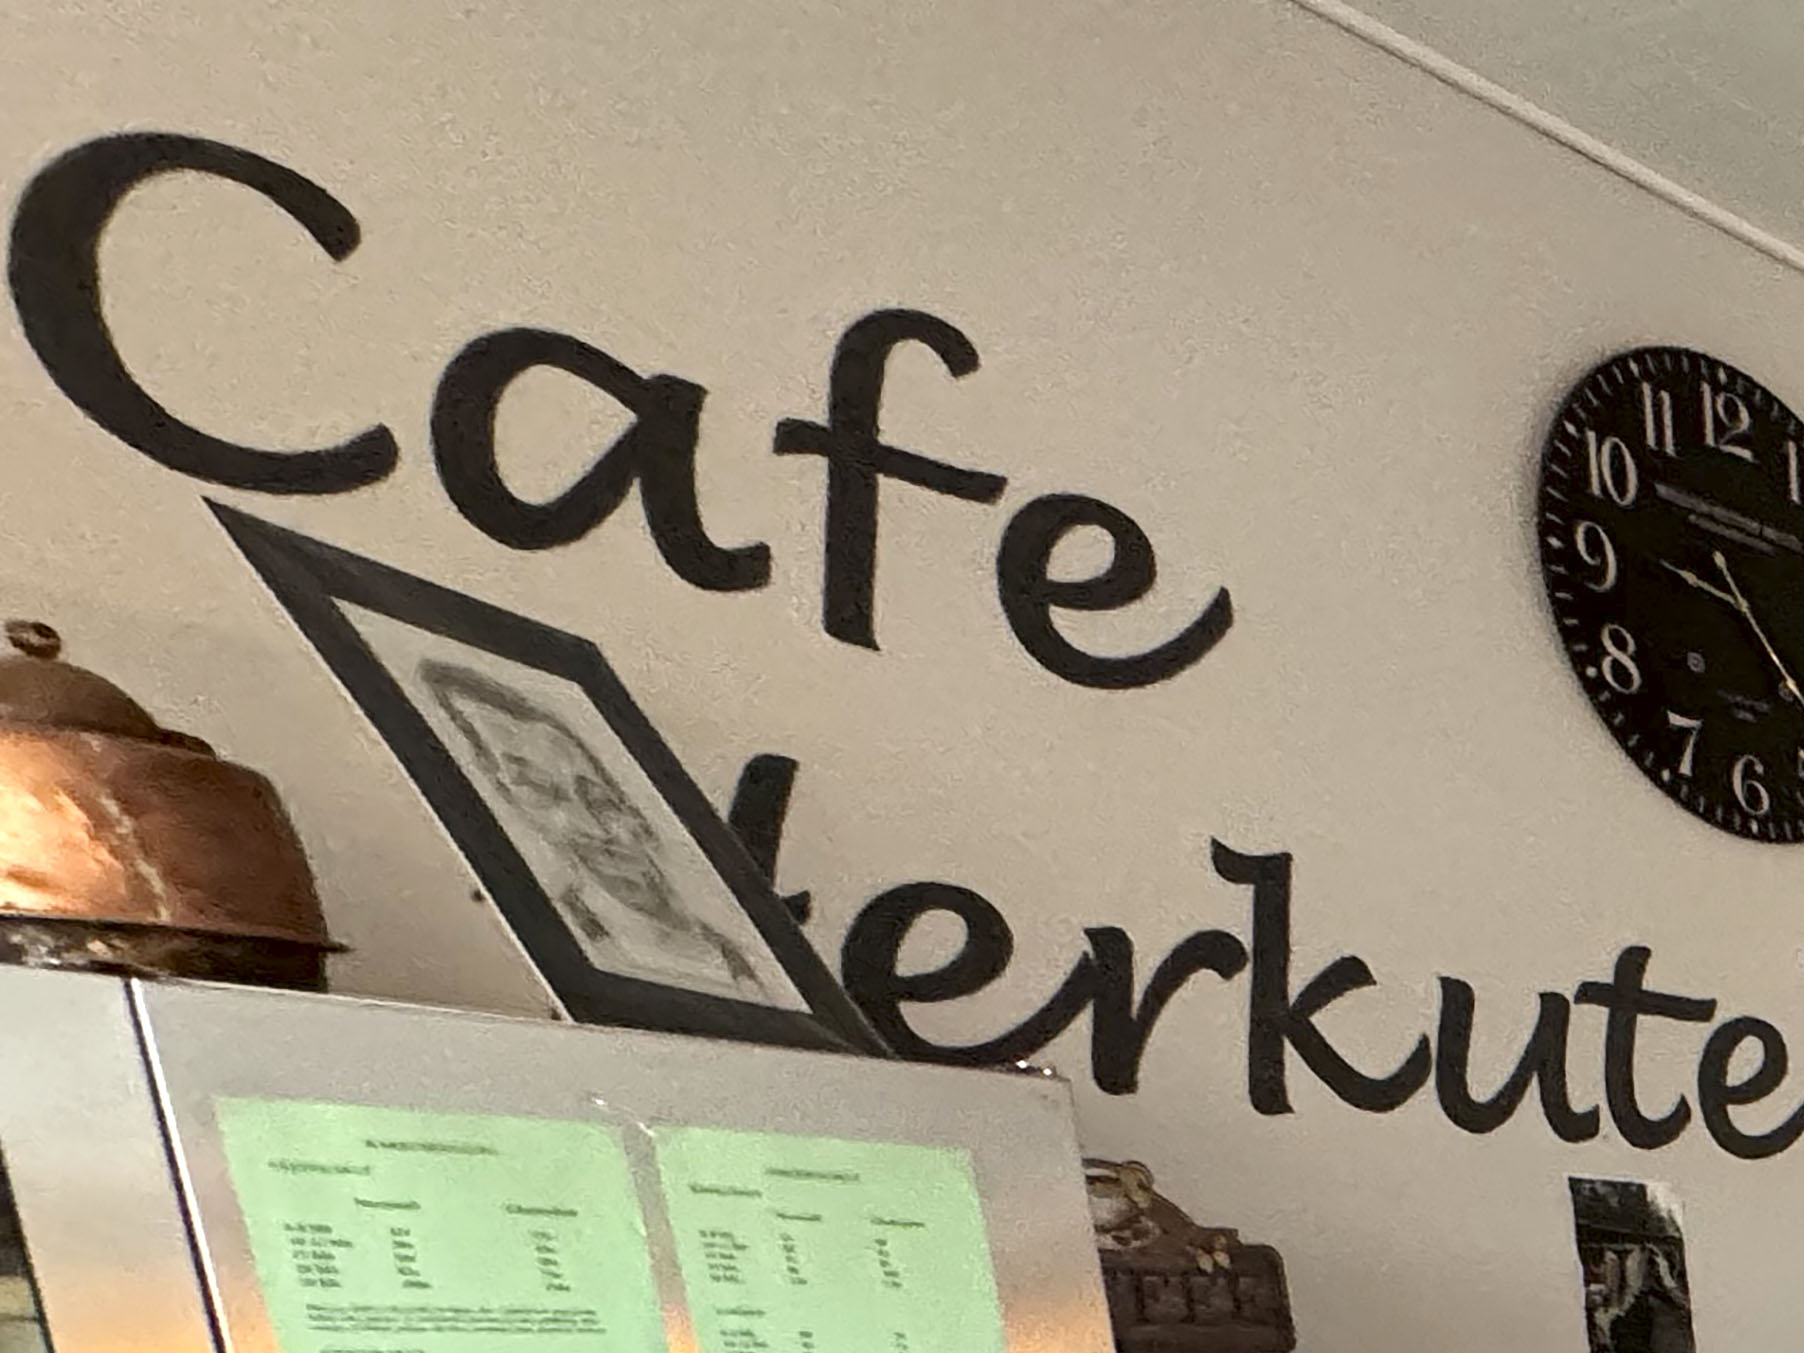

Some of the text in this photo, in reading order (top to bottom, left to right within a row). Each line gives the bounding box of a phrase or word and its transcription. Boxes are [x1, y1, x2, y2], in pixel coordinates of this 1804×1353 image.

[8, 131, 1234, 690] Cafe
[1641, 382, 1675, 457] 11
[1702, 382, 1757, 463] 12
[1586, 430, 1639, 507] 10
[1788, 441, 1801, 504] 1
[1575, 521, 1617, 592] 9
[1600, 624, 1641, 694] 8
[1667, 712, 1703, 776] 7
[1732, 755, 1770, 816] 6
